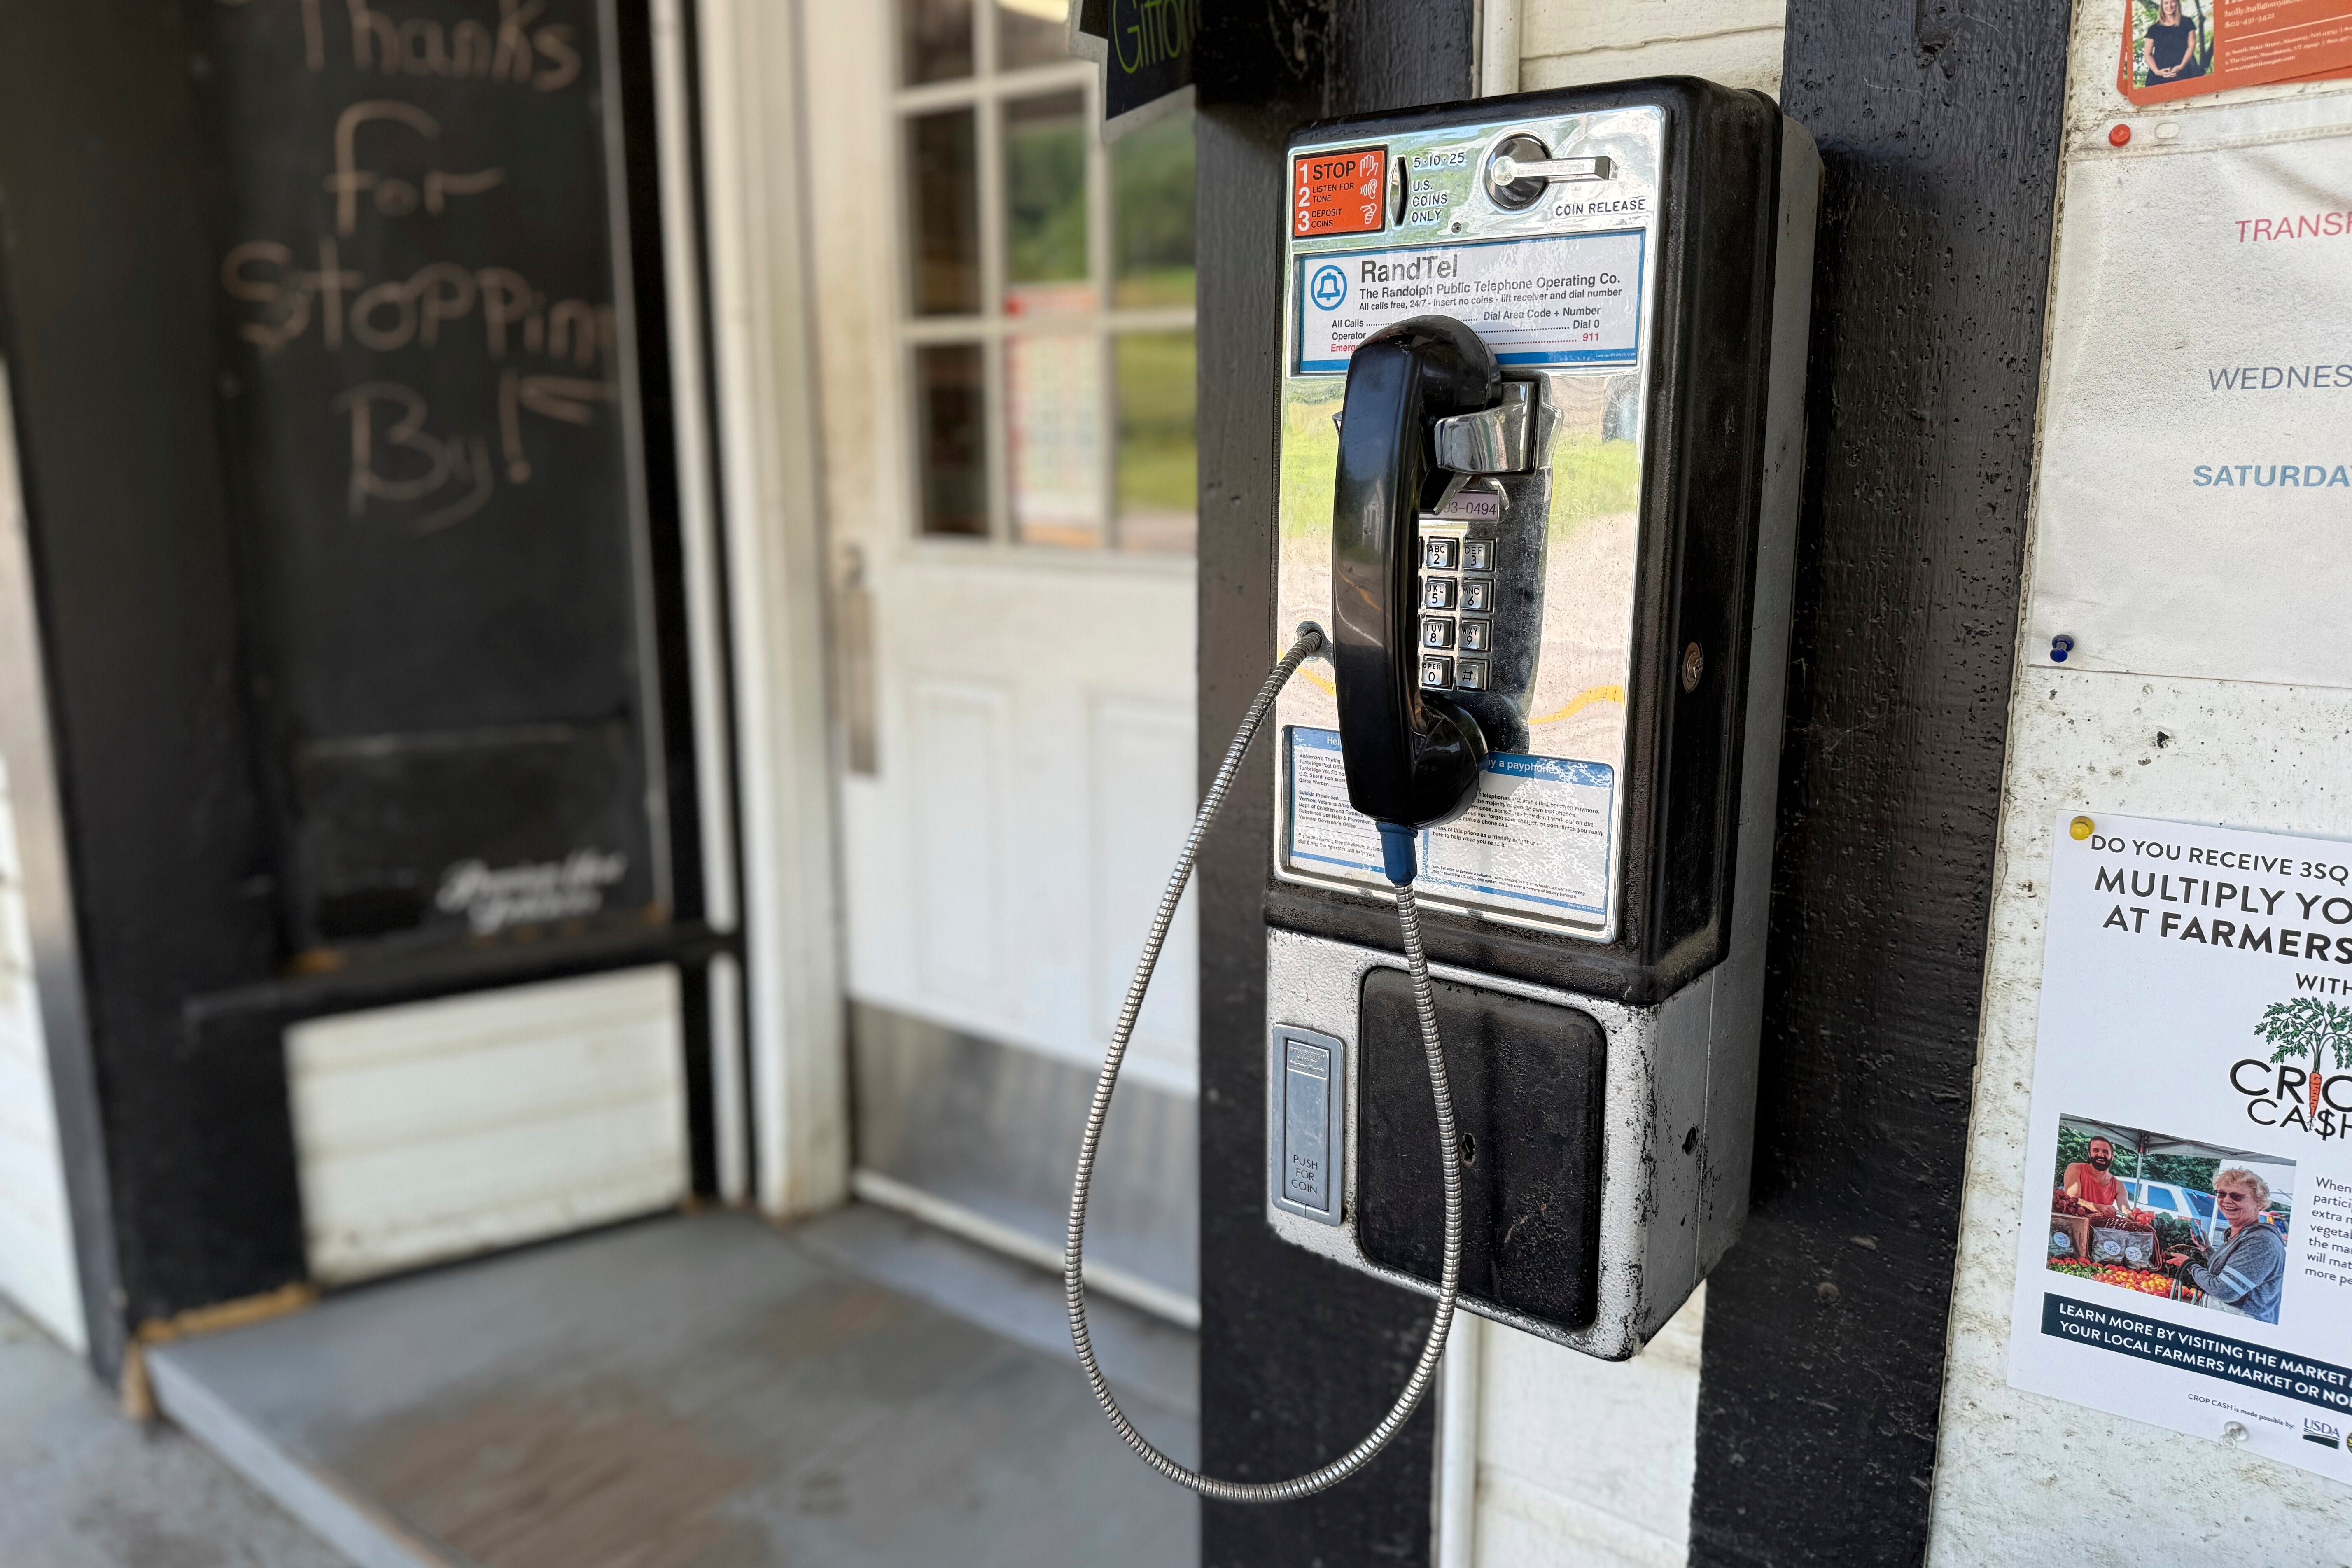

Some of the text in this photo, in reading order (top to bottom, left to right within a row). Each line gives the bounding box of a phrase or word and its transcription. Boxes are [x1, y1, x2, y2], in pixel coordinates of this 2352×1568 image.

[1300, 160, 1356, 184] 1 STOP
[1413, 180, 1433, 191] U.S.
[1298, 182, 1354, 207] 2 LISTEN FOR
[1313, 195, 1332, 203] TONE
[1412, 192, 1448, 207] COINS
[1412, 209, 1442, 223] ONLY
[1555, 198, 1646, 217] COIN RELEASE
[1297, 208, 1342, 231] 3 DEPOSIT
[1311, 219, 1333, 228] COINS
[1361, 254, 1458, 283] RandTel
[1360, 273, 1621, 300] The Randolph Public Telephone Operating Co.
[1359, 303, 1370, 311] All
[1371, 301, 1388, 310] calls
[1391, 301, 1407, 310] free,
[1410, 299, 1426, 308] 24/7
[1471, 297, 1493, 306] coins
[1501, 294, 1511, 303] lift
[1514, 293, 1548, 302] receiver
[1550, 291, 1566, 300] and
[1569, 290, 1584, 299] dial
[1587, 288, 1622, 298] number
[1332, 320, 1342, 328] All
[1344, 319, 1364, 328] Calls
[1484, 311, 1500, 320] Dial
[1503, 310, 1524, 320] Area
[1527, 308, 1551, 317] Code
[1563, 306, 1601, 316] Number
[1332, 331, 1367, 342] Operator
[1573, 320, 1591, 329] Dial
[1331, 333, 1599, 353] Emerg 911
[2208, 364, 2352, 390] WEDNES
[2193, 465, 2352, 487] SATURDA
[1429, 545, 1444, 553] ABC
[1434, 554, 1477, 566] 2 3
[1427, 585, 1444, 593] JKL
[1432, 593, 1474, 606] 5 6
[1425, 624, 1442, 632] TUV
[1430, 633, 1473, 645] 8 9
[1327, 736, 1340, 745] Hel
[2091, 835, 2352, 887] DO YOU RECEIVE 3SQ
[2094, 866, 2352, 925] MULTIPLY YO
[2103, 904, 2352, 965] AT FARMERS
[1293, 1155, 1318, 1171] PUSH
[1296, 1168, 1314, 1182] FOR
[1291, 1179, 1317, 1195] COIN
[2316, 1176, 2352, 1193] When
[2313, 1195, 2352, 1213] partici
[2312, 1209, 2342, 1222] extra
[2309, 1237, 2329, 1249] the
[2307, 1252, 2326, 1263] will
[2305, 1268, 2336, 1281] more
[2060, 1302, 2347, 1386] LEARN MORE BY VISITING THE MARKET
[2060, 1321, 2100, 1341] YOUR
[2104, 1332, 2151, 1354] LOCAL
[2154, 1346, 2224, 1372] FARMERS
[2228, 1363, 2292, 1390] MARKET
[2294, 1382, 2318, 1399] OR
[2188, 1393, 2210, 1404] CROP
[2211, 1400, 2233, 1410] CASH
[2240, 1409, 2258, 1418] made
[2259, 1414, 2284, 1426] possible
[2304, 1417, 2341, 1438] USDA
